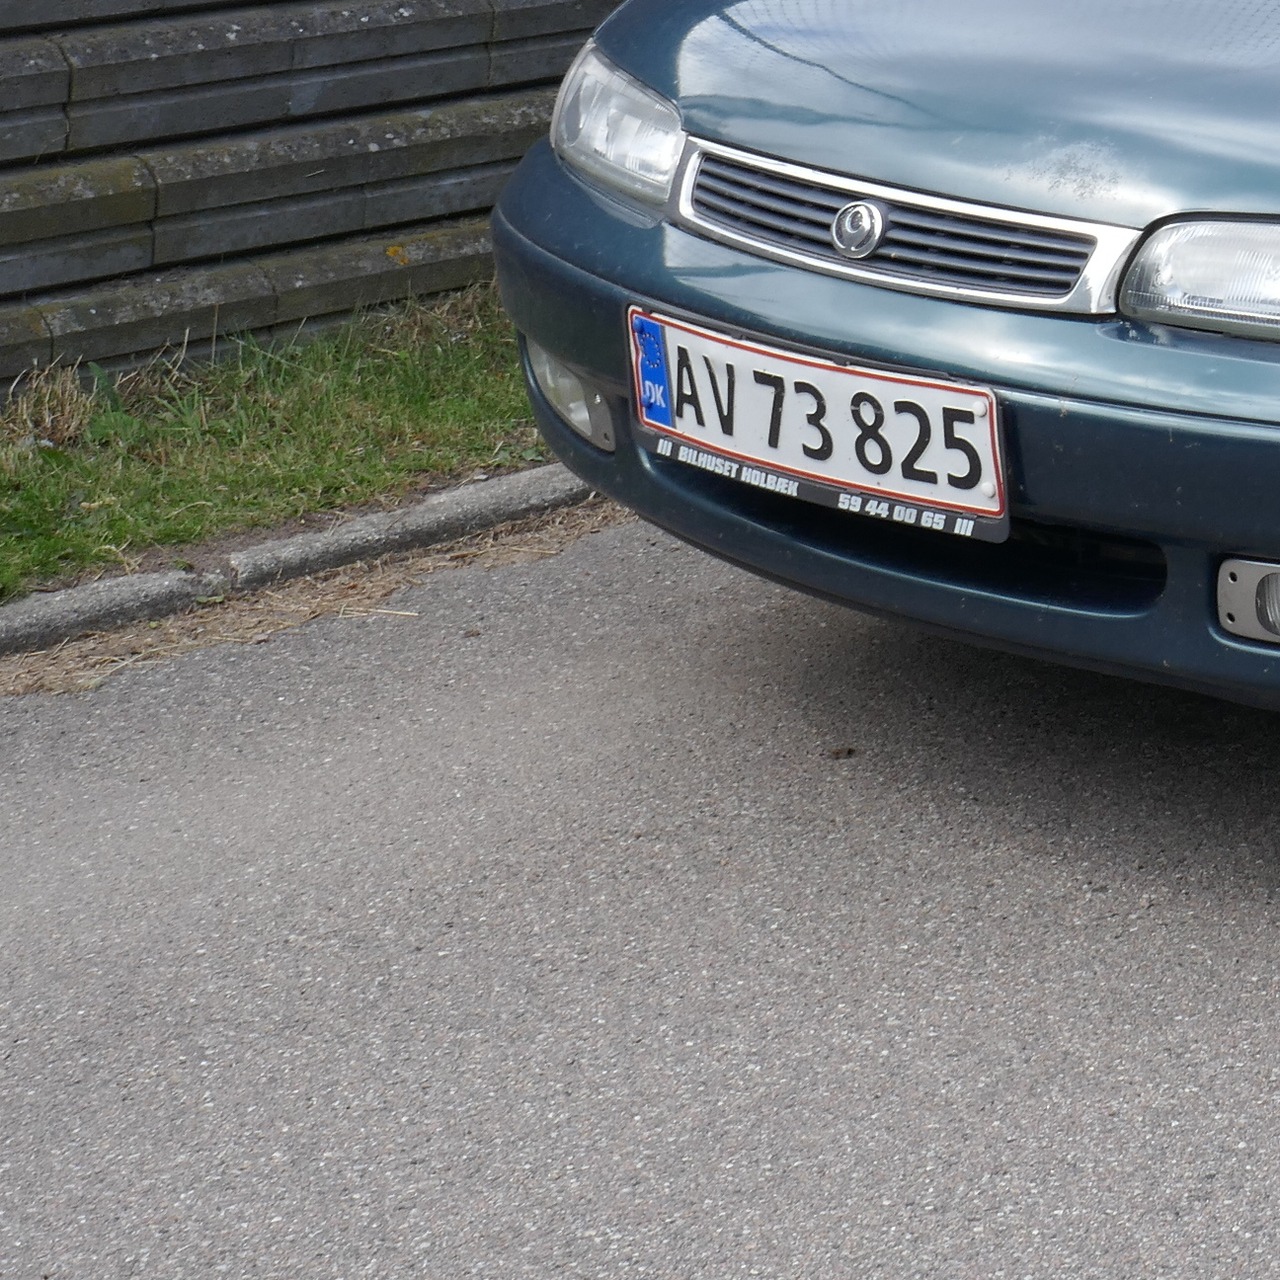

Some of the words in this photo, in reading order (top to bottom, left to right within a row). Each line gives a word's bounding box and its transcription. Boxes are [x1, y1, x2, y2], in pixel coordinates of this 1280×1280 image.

[644, 380, 666, 408] DK
[675, 345, 736, 437] AV
[753, 369, 834, 461] 73
[850, 391, 983, 490] 825
[677, 445, 740, 479] BILHUSET
[740, 466, 800, 497] HOLBÆK
[838, 493, 862, 513] 59
[865, 499, 890, 519] 44
[892, 505, 917, 524] 00
[920, 511, 946, 530] 65
